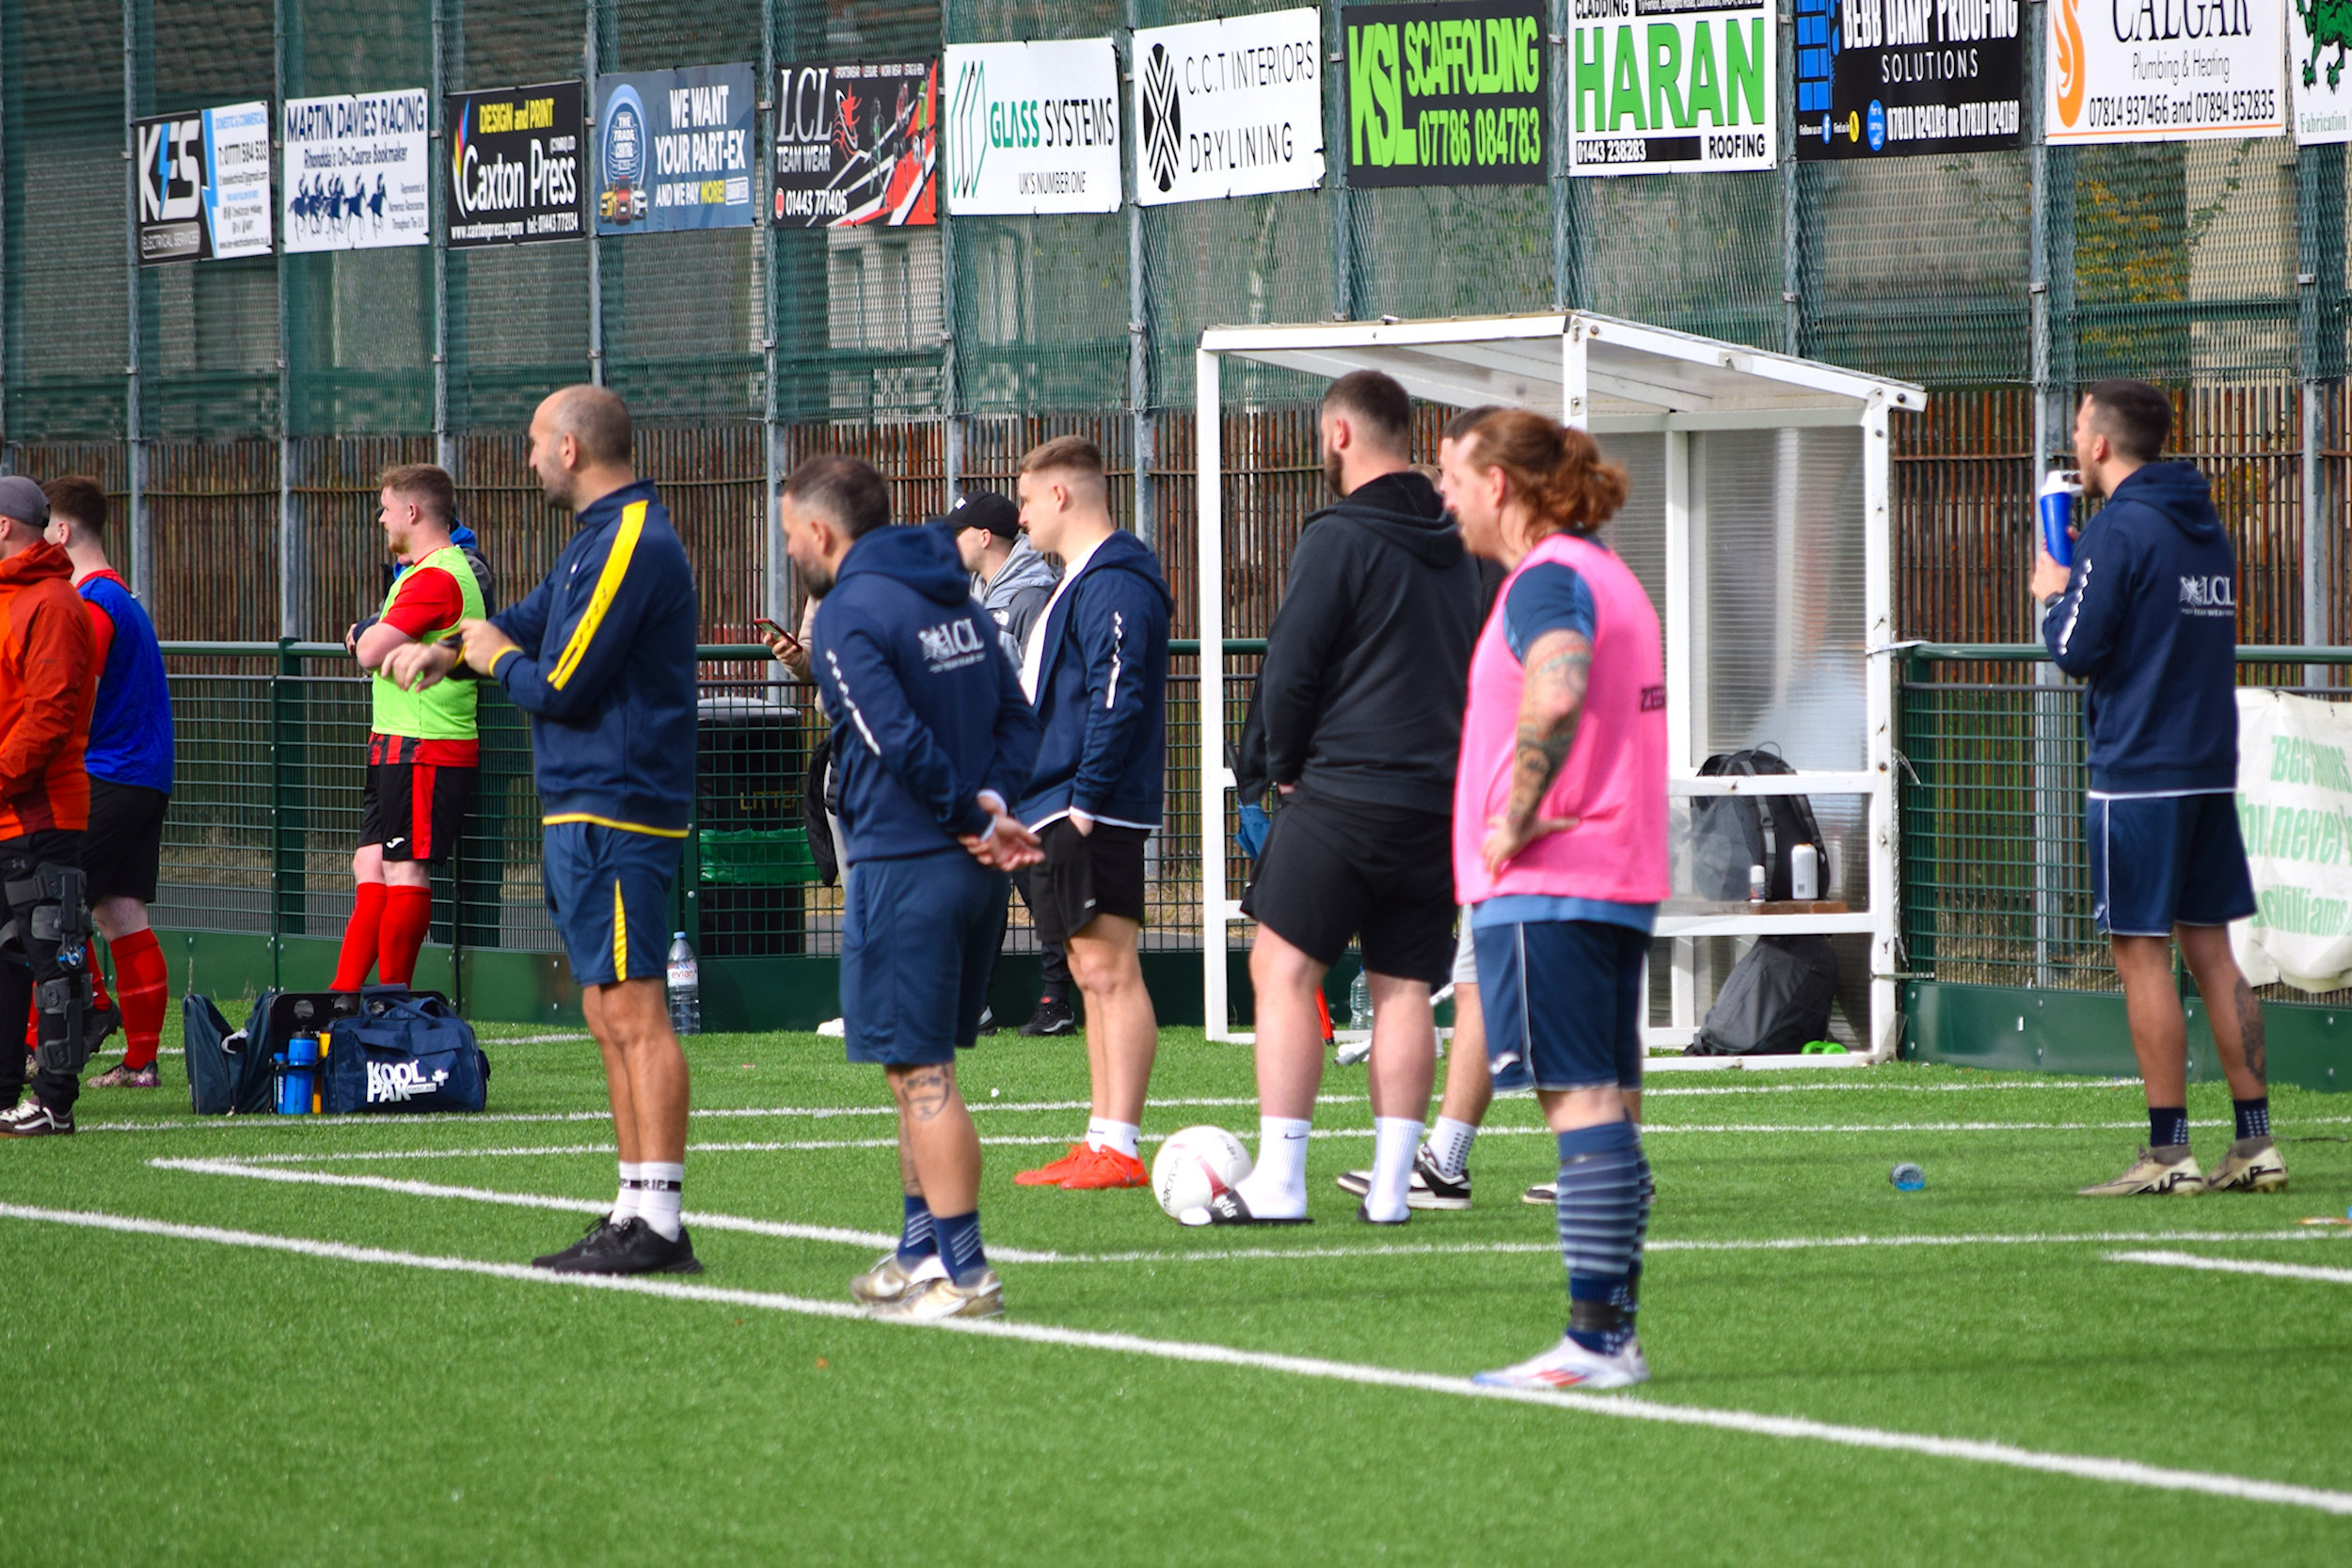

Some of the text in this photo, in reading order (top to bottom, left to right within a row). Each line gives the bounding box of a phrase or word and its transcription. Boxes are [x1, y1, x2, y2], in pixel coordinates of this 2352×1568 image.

[1575, 0, 1629, 19] CLADDING
[1842, 0, 2019, 50] BEBB DAMP PROOFING
[1185, 40, 1314, 95] C.C.T INTERIORS
[1404, 15, 1539, 97] SCAFFOLDING
[1882, 48, 1979, 83] SOLUTIONS
[2133, 48, 2230, 86] Plumbing & Heating
[1575, 17, 1765, 133] HARAN
[669, 85, 729, 129] WE WANT
[776, 67, 834, 143] LCL
[1347, 22, 1418, 167] KSL
[2089, 88, 2275, 127] 07814 937466 and 07894 952835
[287, 96, 424, 142] MARTIN DAVIES RACING
[478, 98, 554, 134] DESIGN and PRINT
[990, 98, 1115, 148] GLASS SYSTEMS
[1886, 106, 1914, 141] 07810
[1960, 102, 1986, 136] 07810
[2300, 110, 2347, 134] Fabrication
[373, 140, 407, 164] Bookmaker
[655, 129, 746, 175] YOUR PART-EX
[1190, 121, 1293, 173] DRYLINING
[1419, 106, 1541, 166] 07786 084783
[1577, 139, 1647, 164] 01443 238283
[1708, 134, 1766, 160] ROOFING
[462, 138, 577, 212] Caxton Press
[776, 144, 831, 173] TEAM WEAR
[655, 182, 673, 207] AND
[673, 182, 686, 206] WE
[687, 182, 700, 205] PAY
[1037, 171, 1070, 194] NUMBER
[1071, 171, 1086, 194] ONE
[786, 189, 813, 216] 01443
[142, 232, 173, 251] ELECTRICAL
[2201, 575, 2235, 605] LCL
[671, 970, 694, 979] evian
[367, 1059, 426, 1084] KOOL
[367, 1081, 412, 1102] PAK
